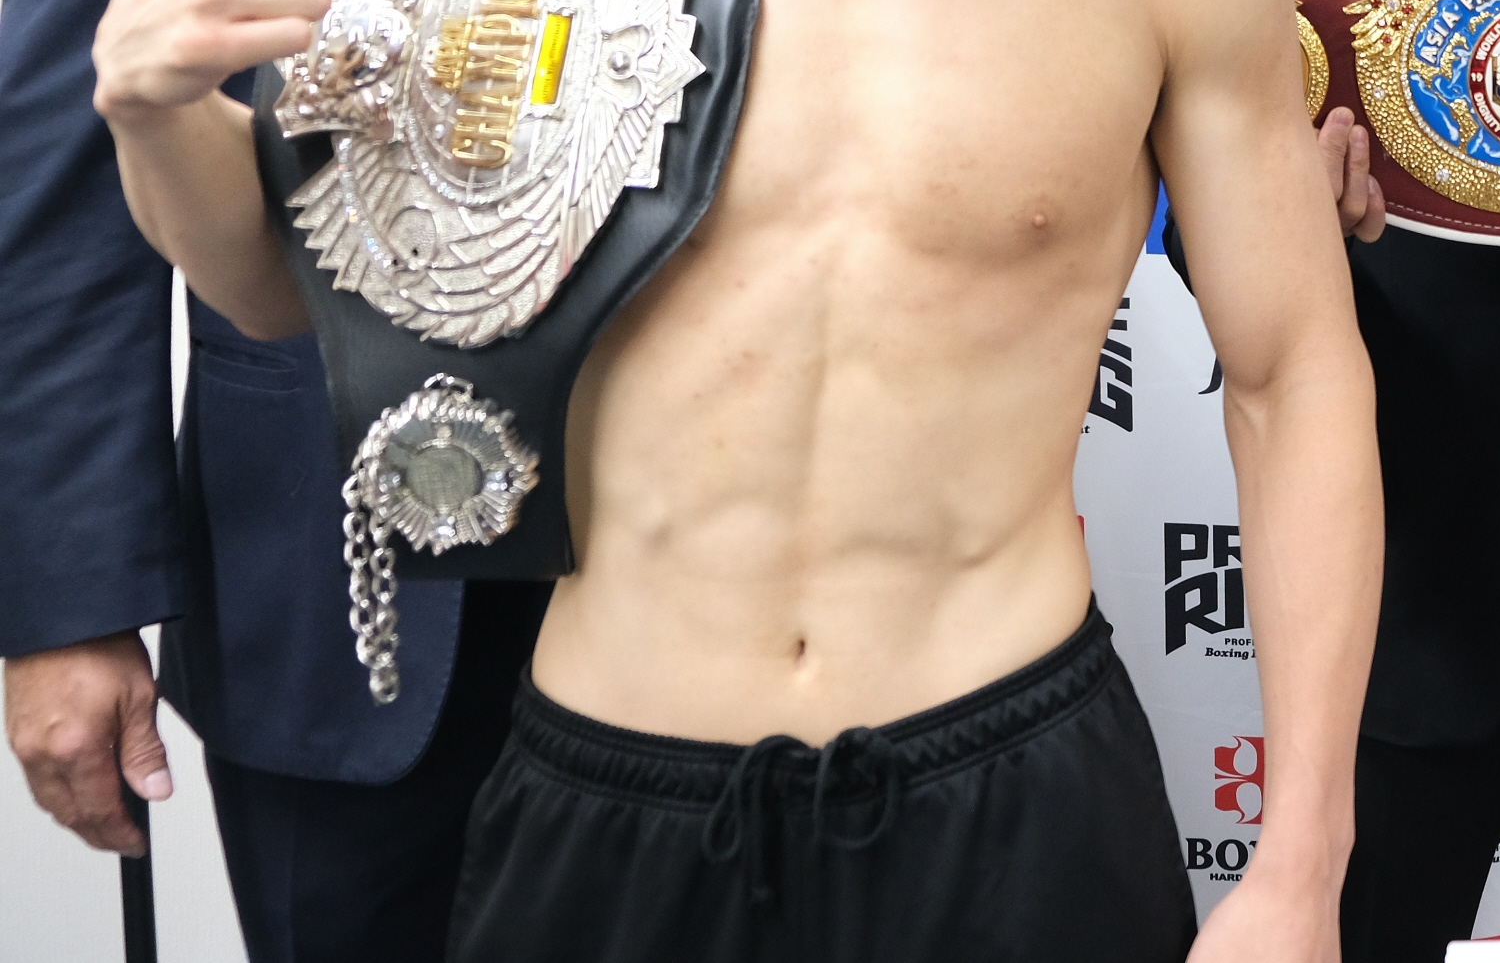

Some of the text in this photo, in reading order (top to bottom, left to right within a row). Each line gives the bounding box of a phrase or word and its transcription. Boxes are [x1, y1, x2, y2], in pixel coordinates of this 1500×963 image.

[1420, 9, 1461, 64] ASIA
[1471, 72, 1483, 82] 19
[1204, 647, 1250, 660] Boxing
[1209, 872, 1243, 882] HARD
